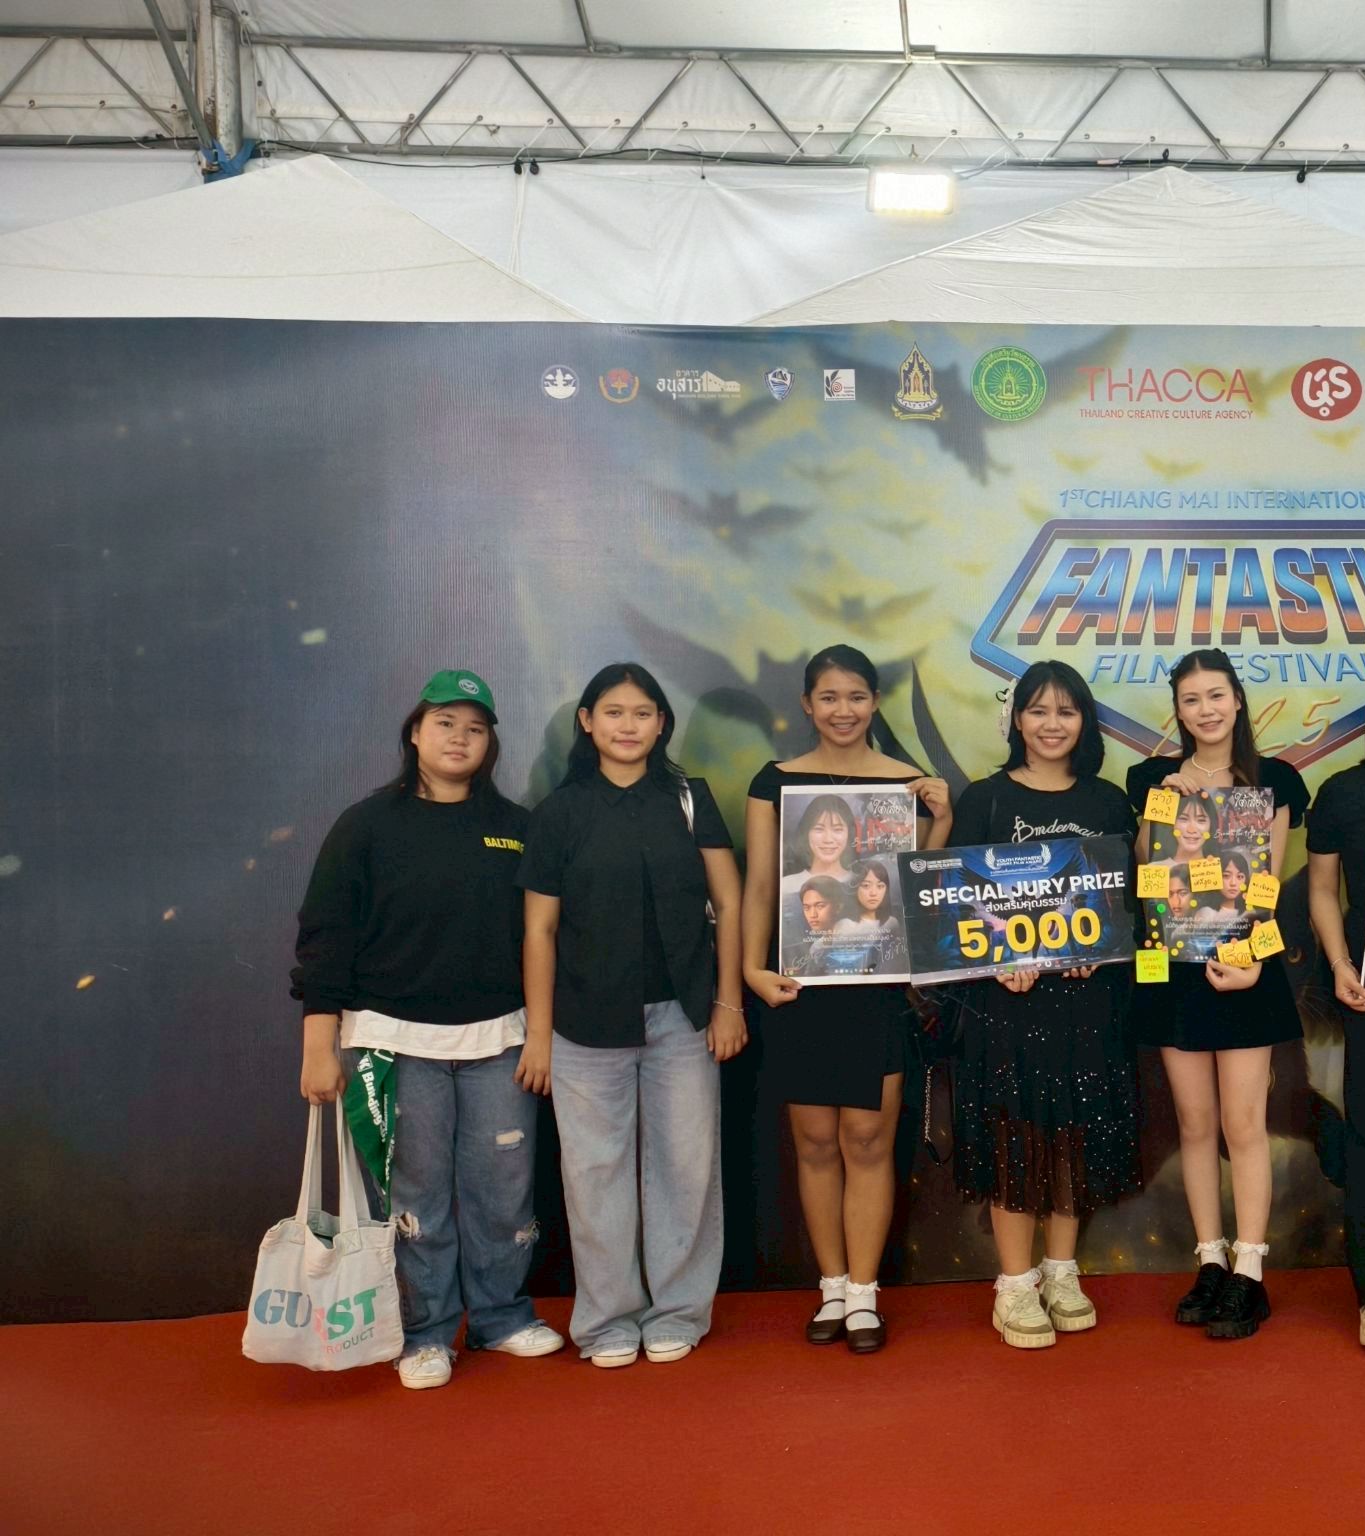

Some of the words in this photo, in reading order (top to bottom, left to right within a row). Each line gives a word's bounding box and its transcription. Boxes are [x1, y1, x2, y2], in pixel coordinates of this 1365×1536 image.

[1077, 367, 1253, 403] THACCA
[1080, 408, 1124, 419] THAILAND
[1127, 409, 1170, 419] CREATIVE
[1172, 409, 1213, 420] CULTURE
[1215, 409, 1253, 420] AGENCY
[1084, 490, 1172, 509] CHIANG
[1179, 490, 1221, 509] MAI
[919, 883, 1009, 907] SPECIAL
[1011, 876, 1065, 898] JURY
[1069, 871, 1126, 892] PRIZE
[985, 897, 1068, 915] ส่งเสริมคุณธรรม
[957, 907, 1101, 963] 5,000
